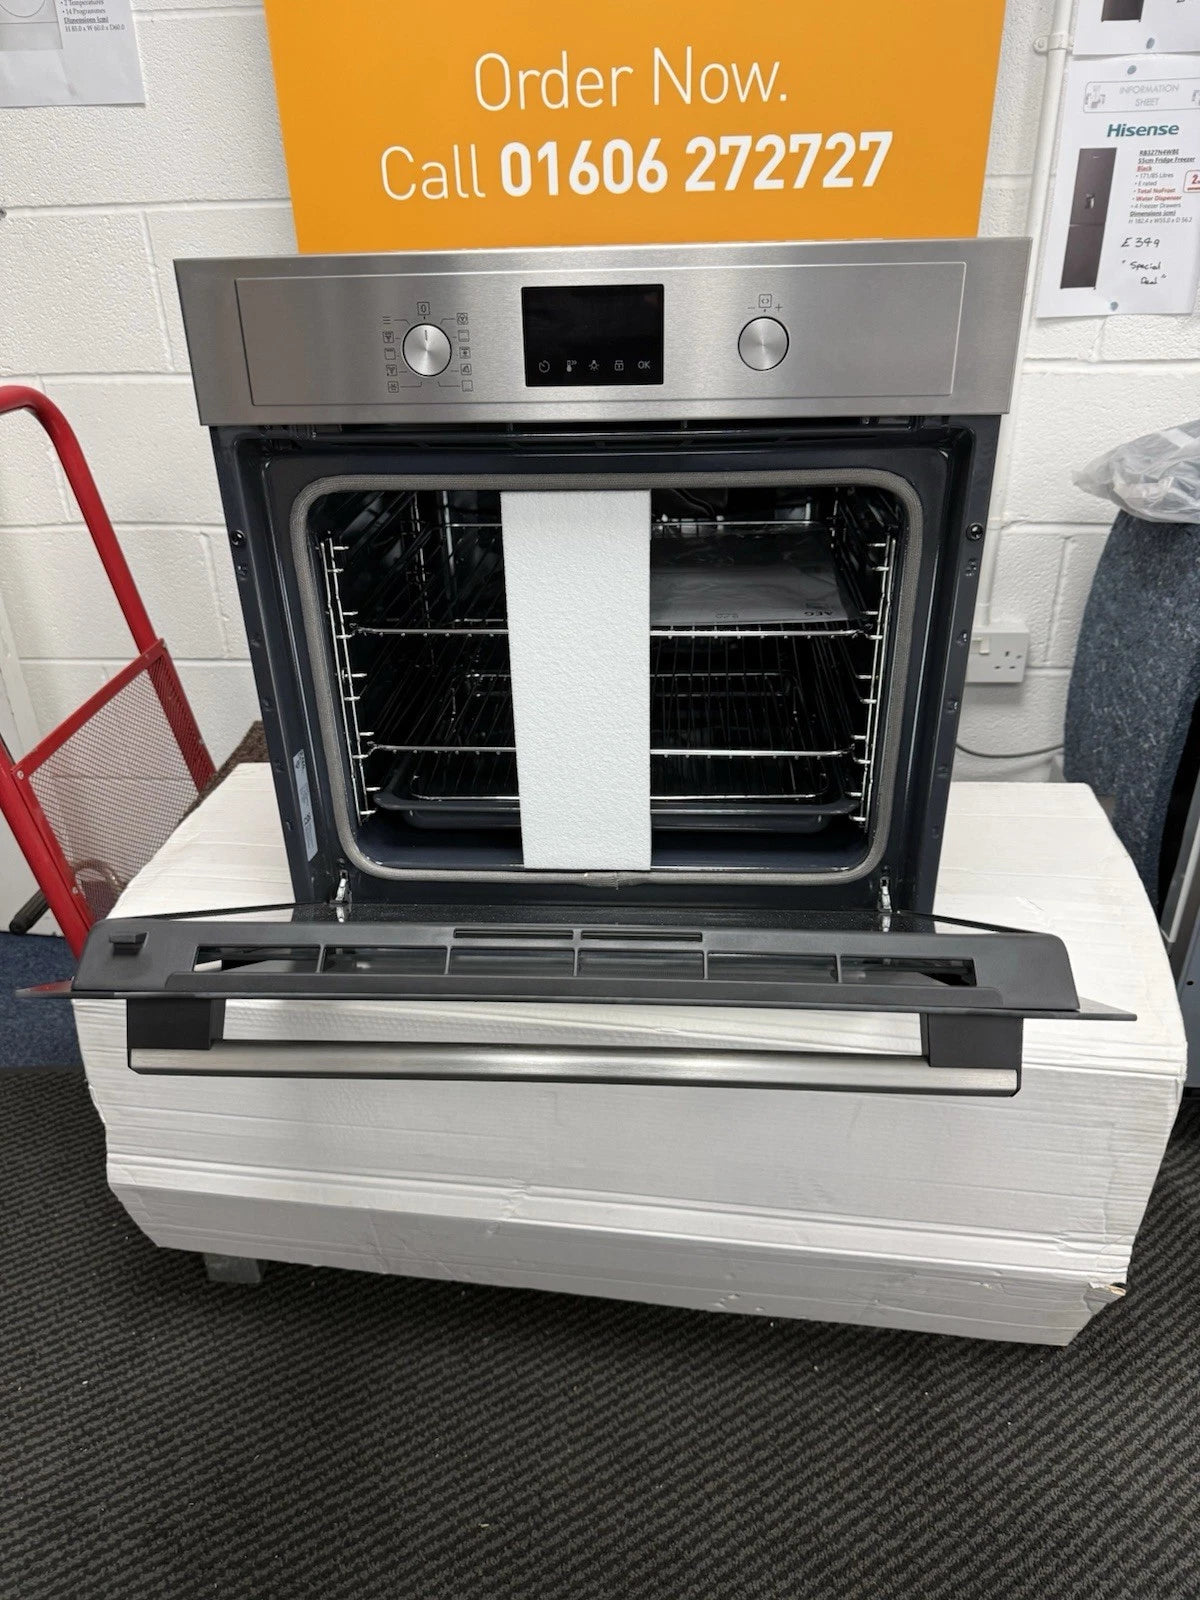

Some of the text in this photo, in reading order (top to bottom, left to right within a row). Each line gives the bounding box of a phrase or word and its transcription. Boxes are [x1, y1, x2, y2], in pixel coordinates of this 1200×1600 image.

[476, 46, 787, 110] Order Now.
[1120, 84, 1179, 94] INFORMATION
[1135, 98, 1159, 107] SHEET
[1107, 123, 1179, 137] Hisense
[382, 131, 892, 200] Call 01606 272727
[638, 360, 651, 370] OK
